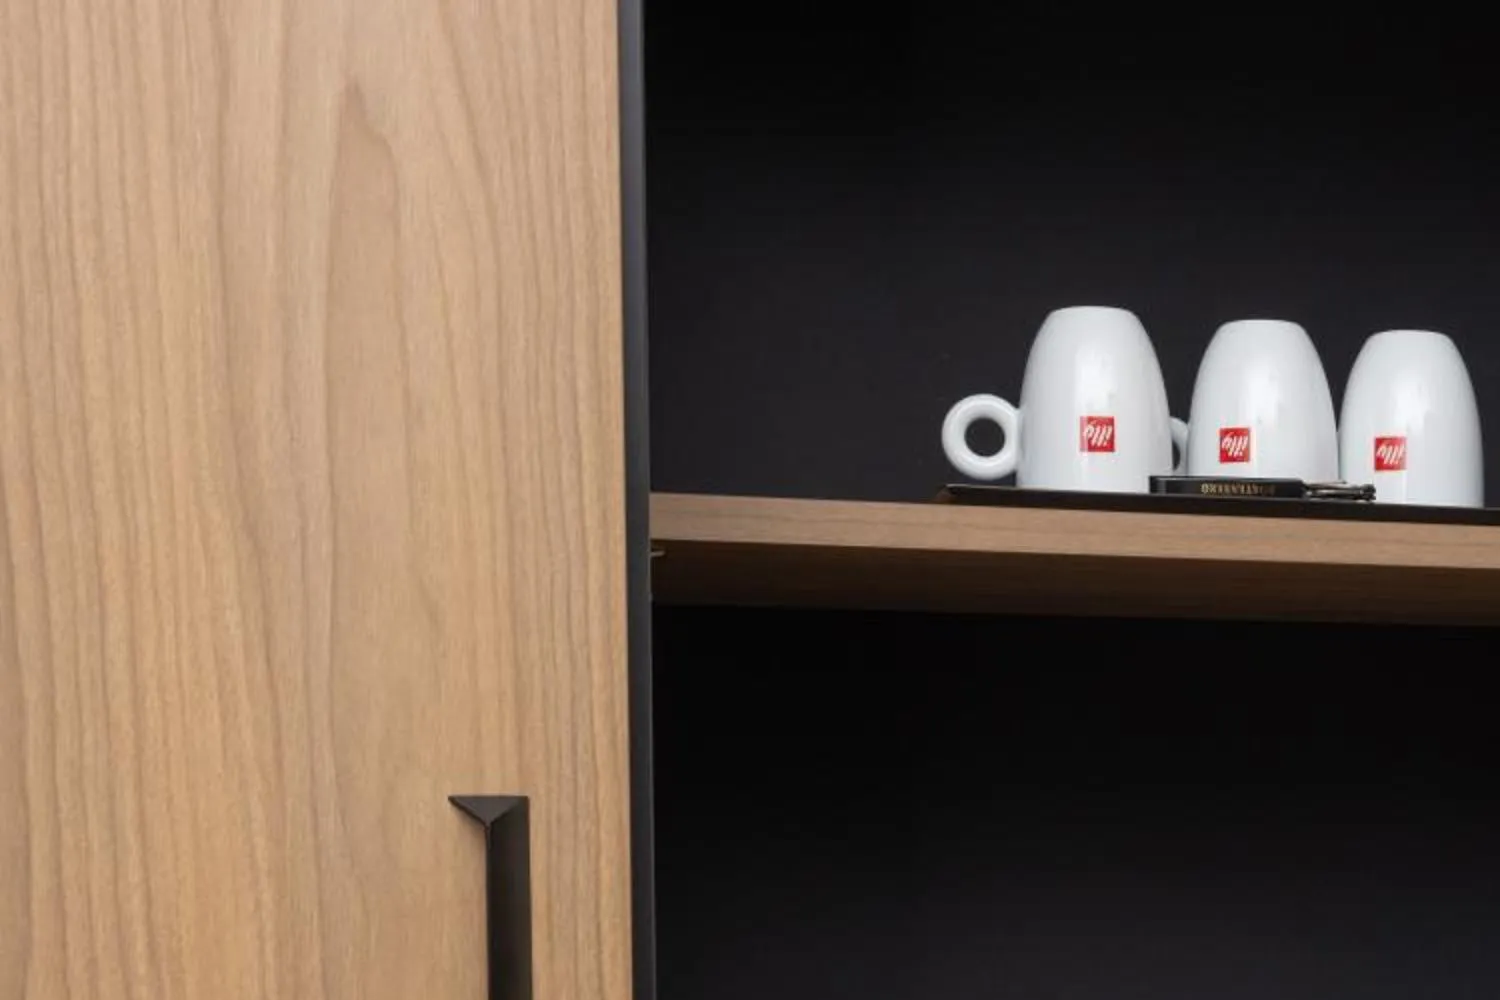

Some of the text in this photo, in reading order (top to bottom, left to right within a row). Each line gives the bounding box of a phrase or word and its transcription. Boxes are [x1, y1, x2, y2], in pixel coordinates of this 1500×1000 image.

[1083, 419, 1113, 448] illy
[1221, 430, 1249, 458] illy
[1376, 441, 1405, 467] illy
